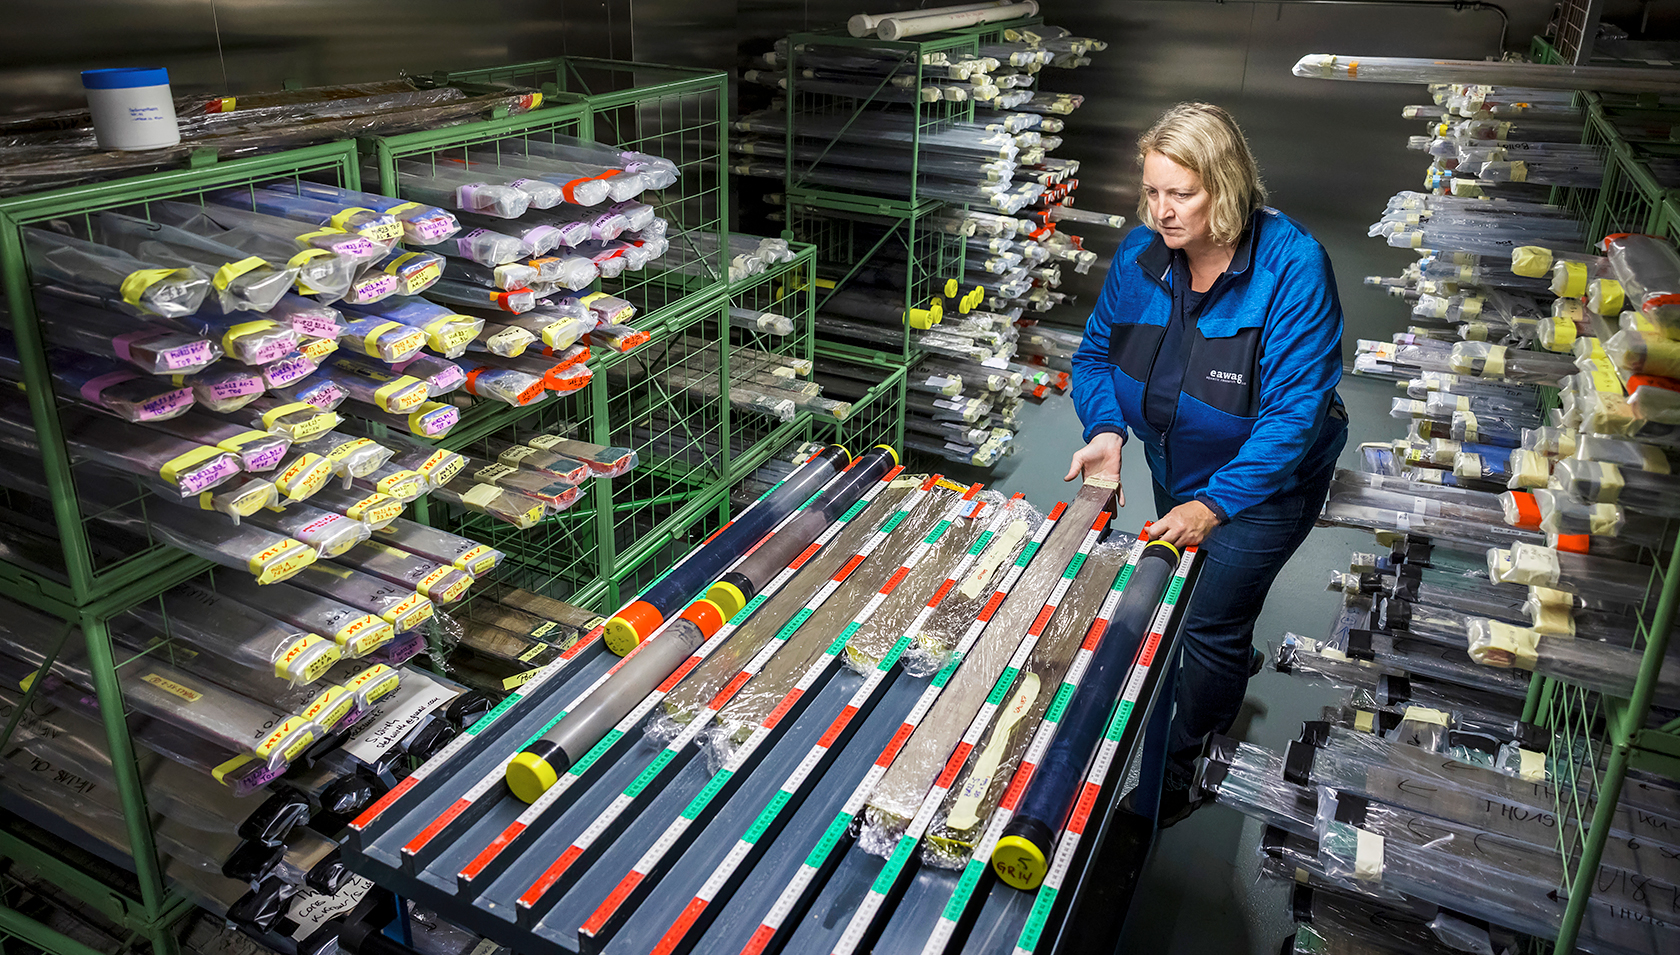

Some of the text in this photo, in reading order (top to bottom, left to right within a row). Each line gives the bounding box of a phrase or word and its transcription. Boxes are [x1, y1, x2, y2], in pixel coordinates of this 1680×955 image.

[376, 287, 387, 295] TOP
[175, 359, 191, 367] TOP
[281, 371, 296, 382] TOP
[1210, 369, 1243, 384] eawag
[149, 406, 165, 416] TOP
[206, 472, 219, 483] TOP
[370, 586, 395, 602] TOP
[326, 610, 351, 626] TOP
[344, 659, 373, 679] TOP
[300, 682, 328, 705] TOP
[254, 711, 285, 739] TOP
[261, 772, 276, 782] TOP
[1480, 796, 1556, 828] THU19
[1017, 857, 1032, 870] 5
